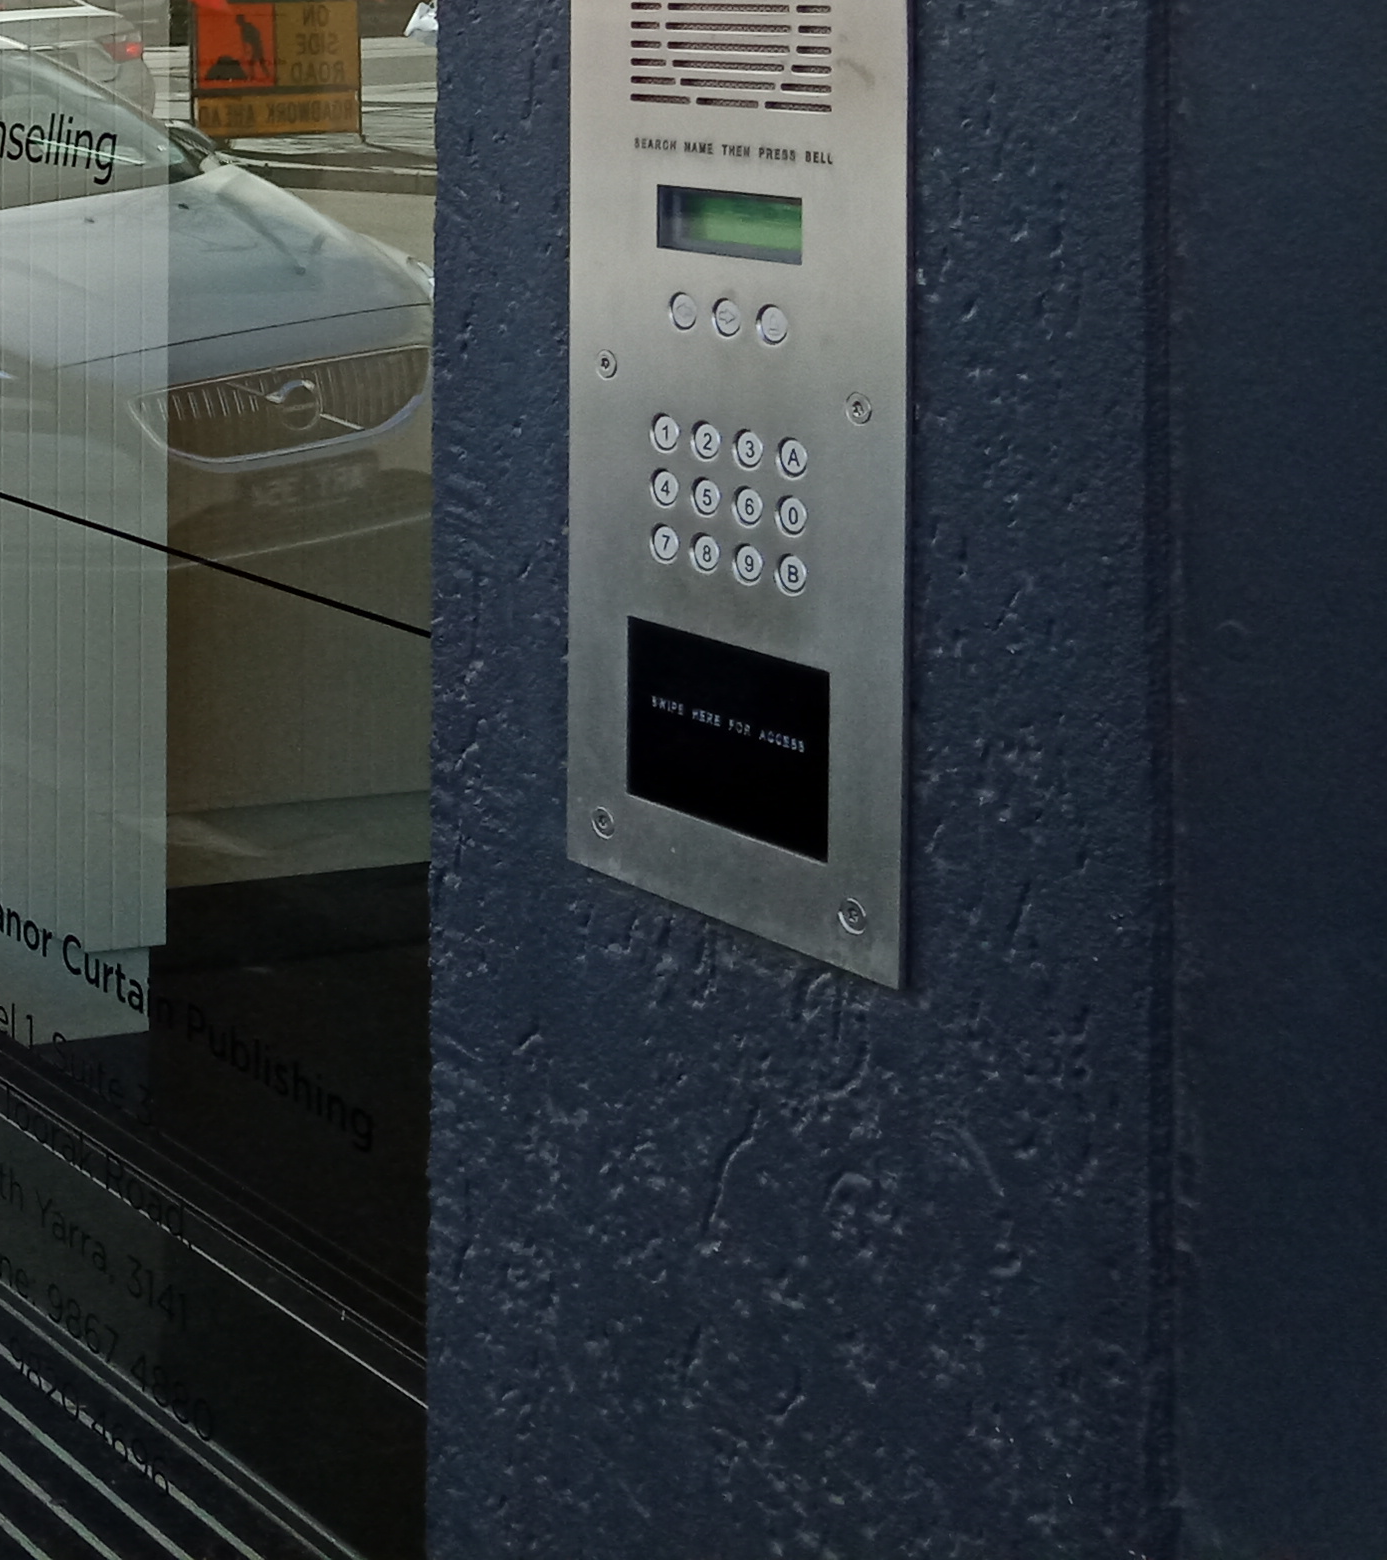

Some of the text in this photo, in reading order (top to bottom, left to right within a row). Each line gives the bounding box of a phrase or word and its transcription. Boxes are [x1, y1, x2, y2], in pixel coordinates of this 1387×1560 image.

[633, 137, 833, 165] SEARCH NAME THEN PRESS BELL
[661, 424, 801, 467] 1 2 3 A
[660, 479, 799, 525] 4 5 6 0
[661, 534, 799, 583] 7 8 9 B
[651, 694, 805, 753] SWIPE HERE FOR ACCESS
[52, 1030, 126, 1110] Suite
[60, 939, 175, 1032] Curtain
[185, 1004, 375, 1155] Publishing
[0, 1081, 93, 1178] Toorak
[47, 1282, 120, 1364] 9867
[126, 1253, 189, 1332] 3141
